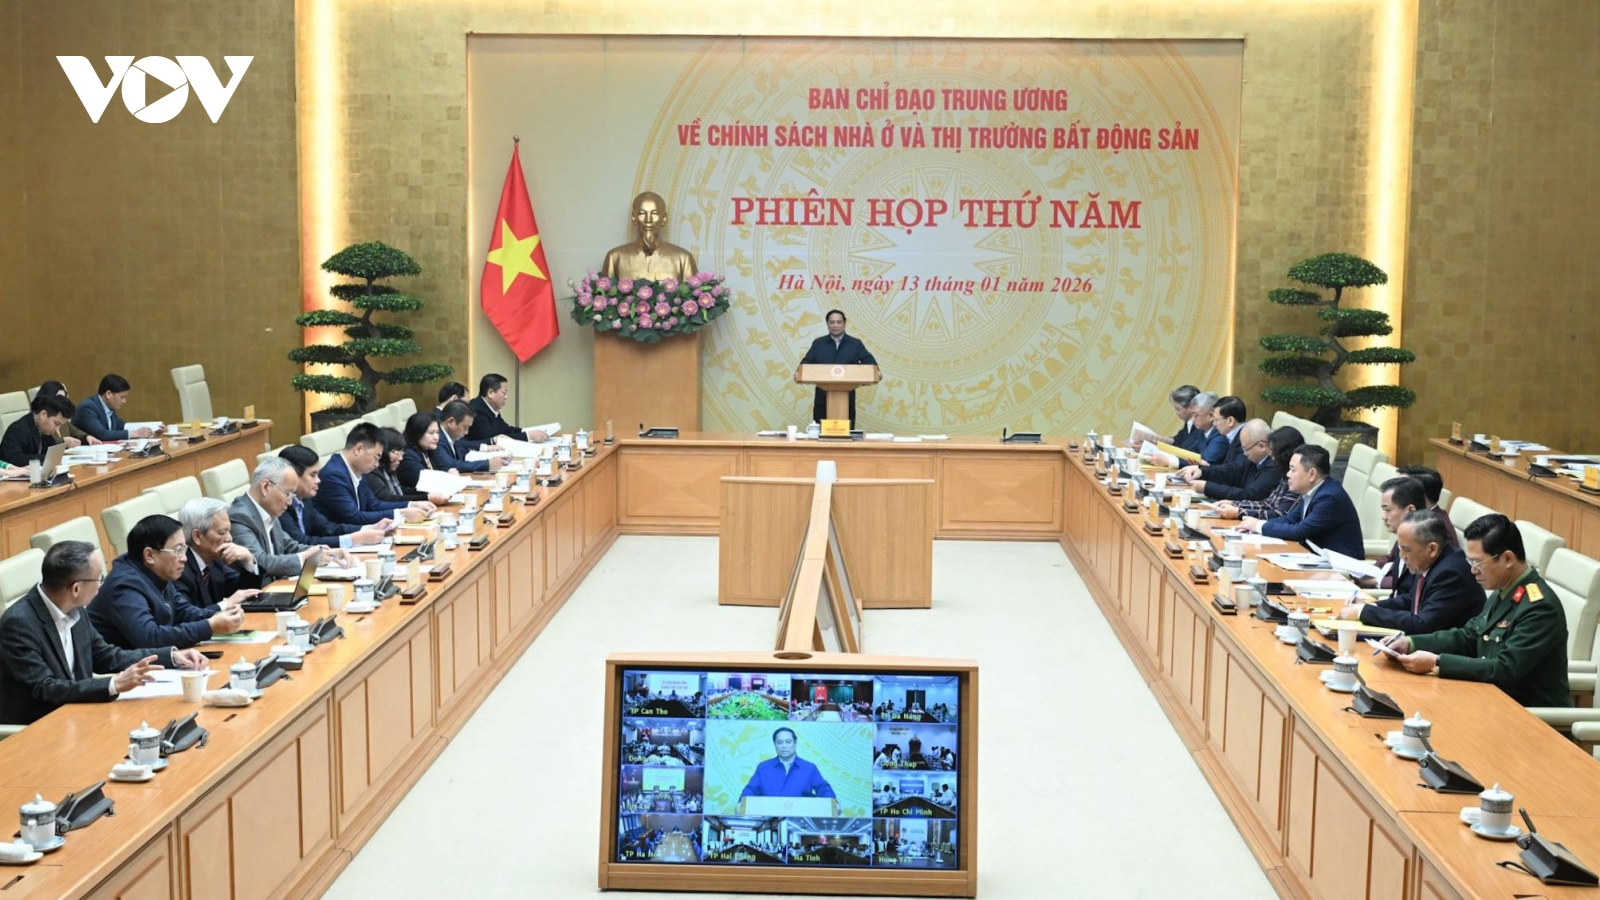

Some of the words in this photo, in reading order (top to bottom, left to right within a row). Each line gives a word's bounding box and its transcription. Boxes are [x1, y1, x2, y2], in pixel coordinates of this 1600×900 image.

[808, 88, 850, 111] BAN
[856, 82, 889, 110] CHỈ
[895, 89, 936, 116] ĐẠO
[942, 89, 1008, 112] TRUNG
[1013, 88, 1068, 112] ƯƠNG
[677, 118, 701, 146] VỀ
[707, 121, 769, 147] CHÍNH
[775, 122, 828, 148] SÁCH
[833, 122, 875, 148] NHÀ
[881, 119, 895, 148] Ở
[900, 122, 926, 149] VÀ
[931, 126, 963, 153] THỊ
[969, 122, 1047, 150] TRƯỜNG
[1053, 119, 1091, 150] BẤT
[1096, 123, 1152, 154] ĐỘNG
[1157, 121, 1200, 151] SẢN
[731, 188, 855, 227] PHIÊN
[867, 197, 948, 235] HỌP
[959, 191, 1043, 229] THỨ
[1049, 192, 1142, 230] NĂM
[778, 274, 805, 290] Hà
[810, 274, 846, 294] Nội,
[851, 275, 894, 295] ngày
[900, 275, 920, 291] 13
[924, 275, 975, 295] tháng
[981, 276, 1001, 292] 01
[1006, 277, 1045, 293] năm
[1050, 277, 1093, 293] 2026
[641, 707, 654, 715] Can
[915, 808, 933, 816] Minh
[625, 850, 634, 858] TP
[636, 850, 646, 858] Ha
[710, 852, 719, 860] TP
[720, 852, 732, 860] Hai
[805, 855, 821, 863] Tinh
